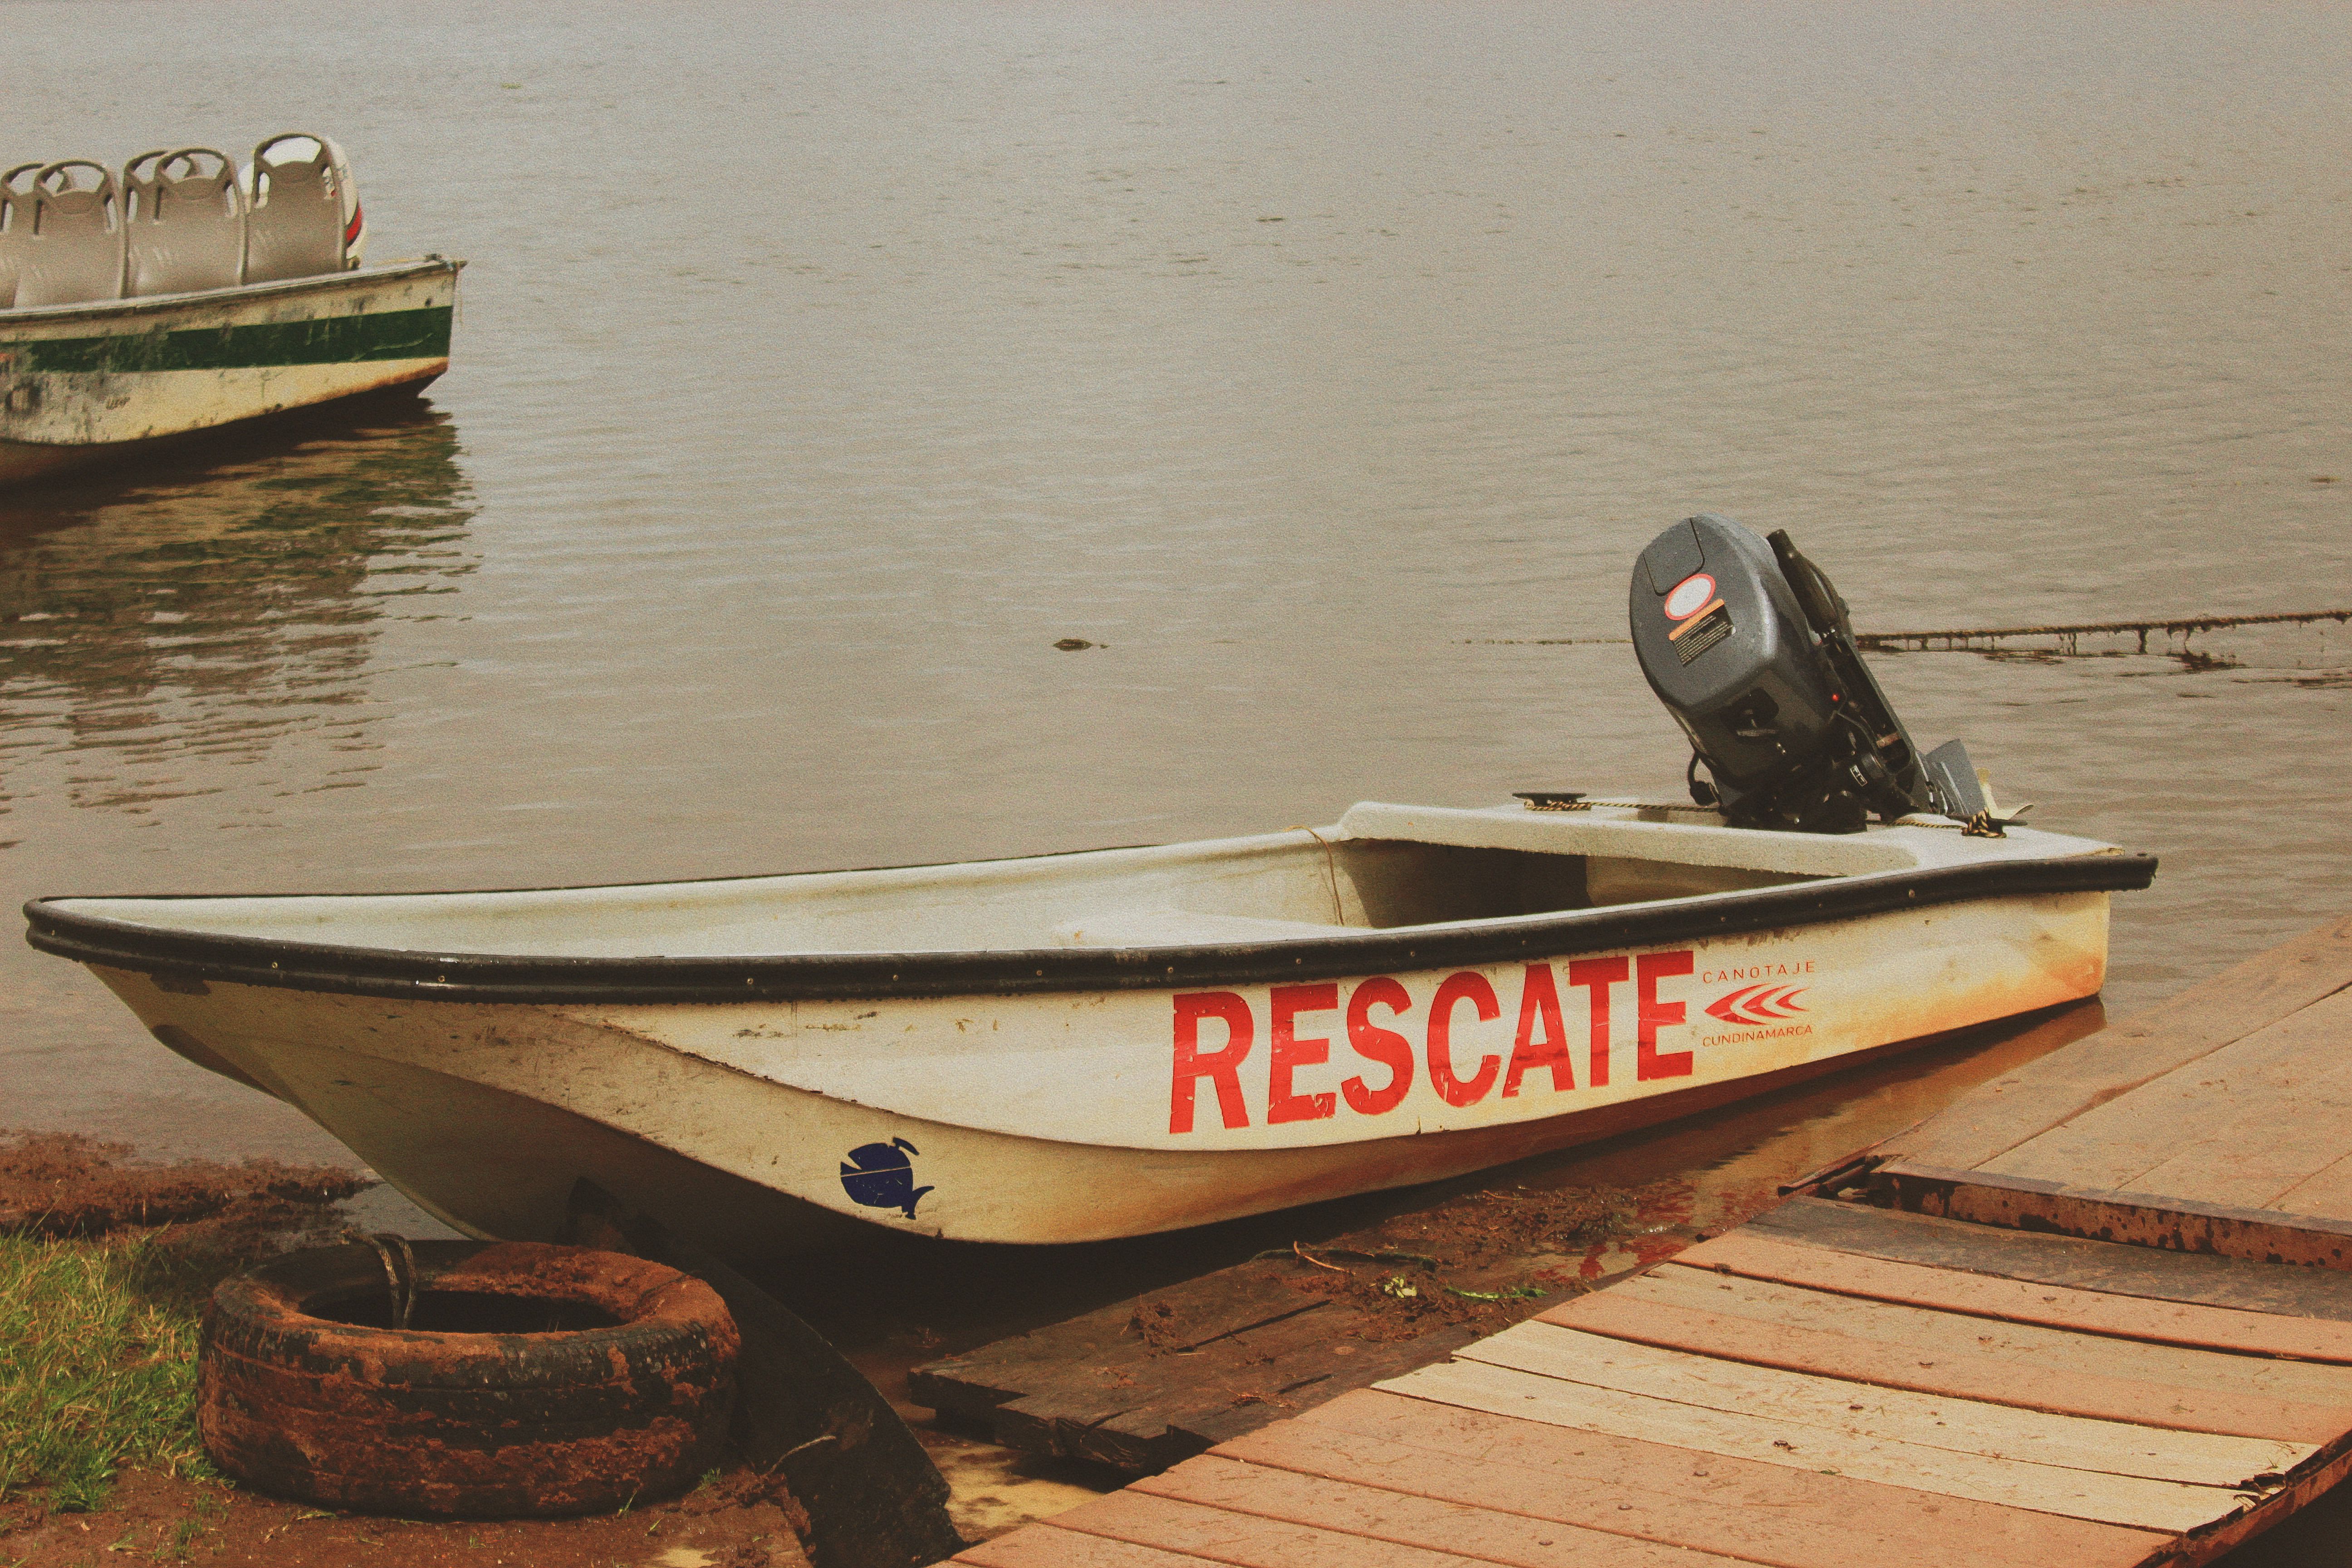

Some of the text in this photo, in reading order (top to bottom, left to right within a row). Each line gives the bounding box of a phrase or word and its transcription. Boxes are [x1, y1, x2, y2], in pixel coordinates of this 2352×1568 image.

[1703, 960, 1815, 984] CANOTAJE
[1170, 951, 1694, 1134] RESCATE
[1703, 1025, 1813, 1047] CUNDINAMARCA
